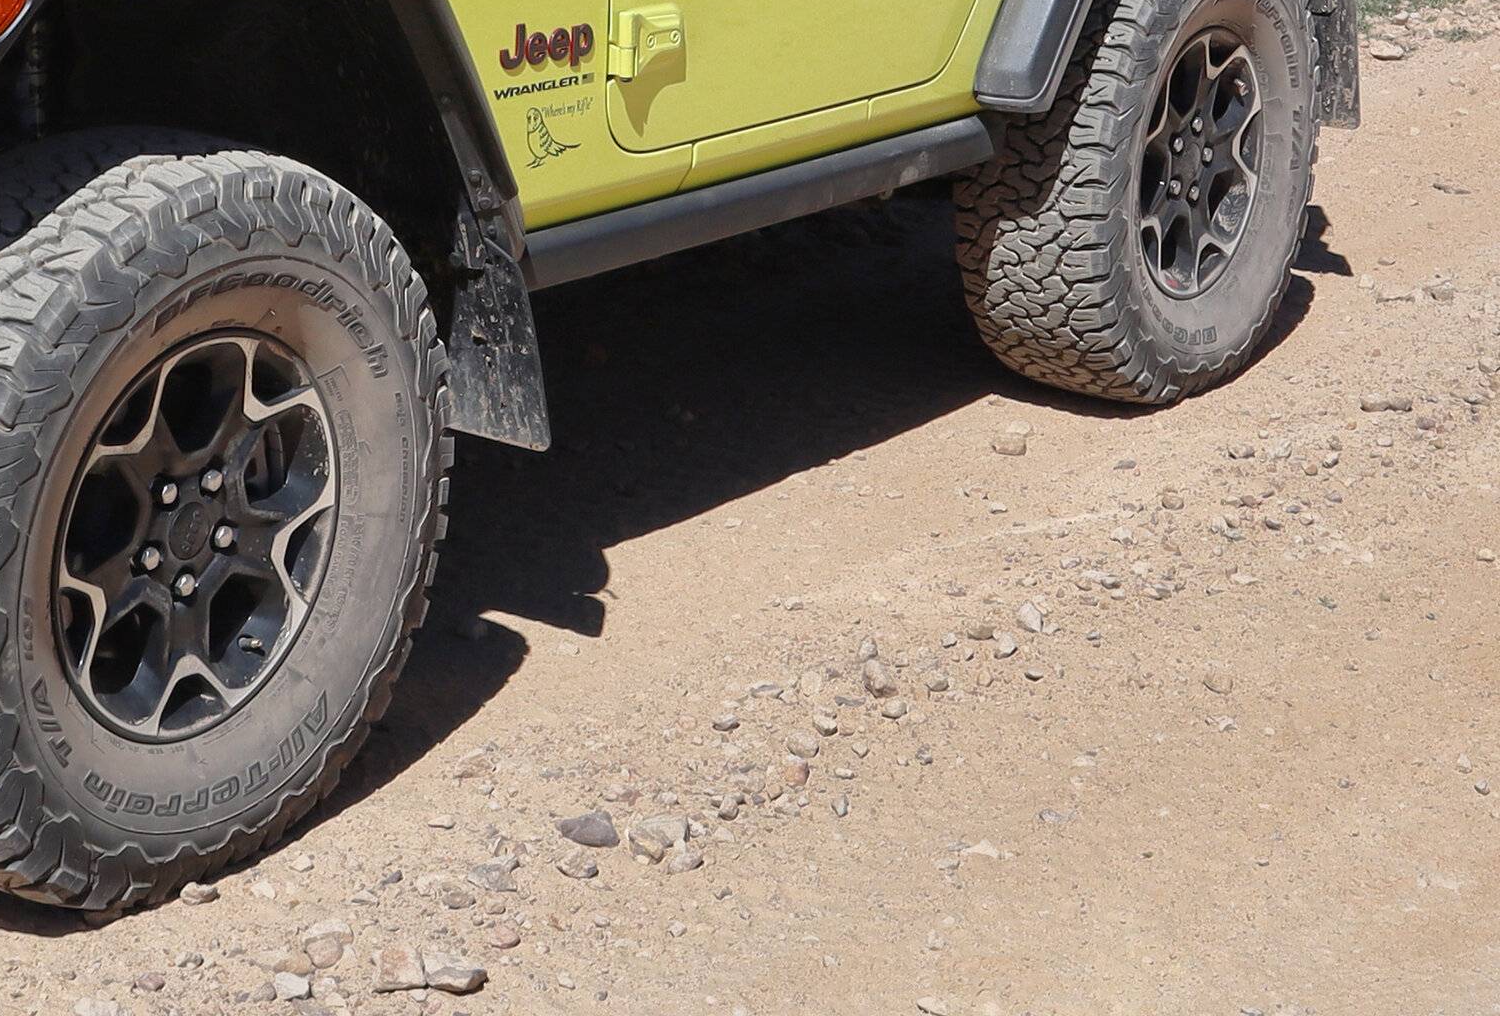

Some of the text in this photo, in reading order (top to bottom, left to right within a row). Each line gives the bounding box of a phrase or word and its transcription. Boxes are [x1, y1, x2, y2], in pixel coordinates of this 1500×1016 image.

[500, 23, 594, 70] Jeep
[493, 75, 579, 100] WRANGLER
[83, 690, 328, 817] All-Terrain
